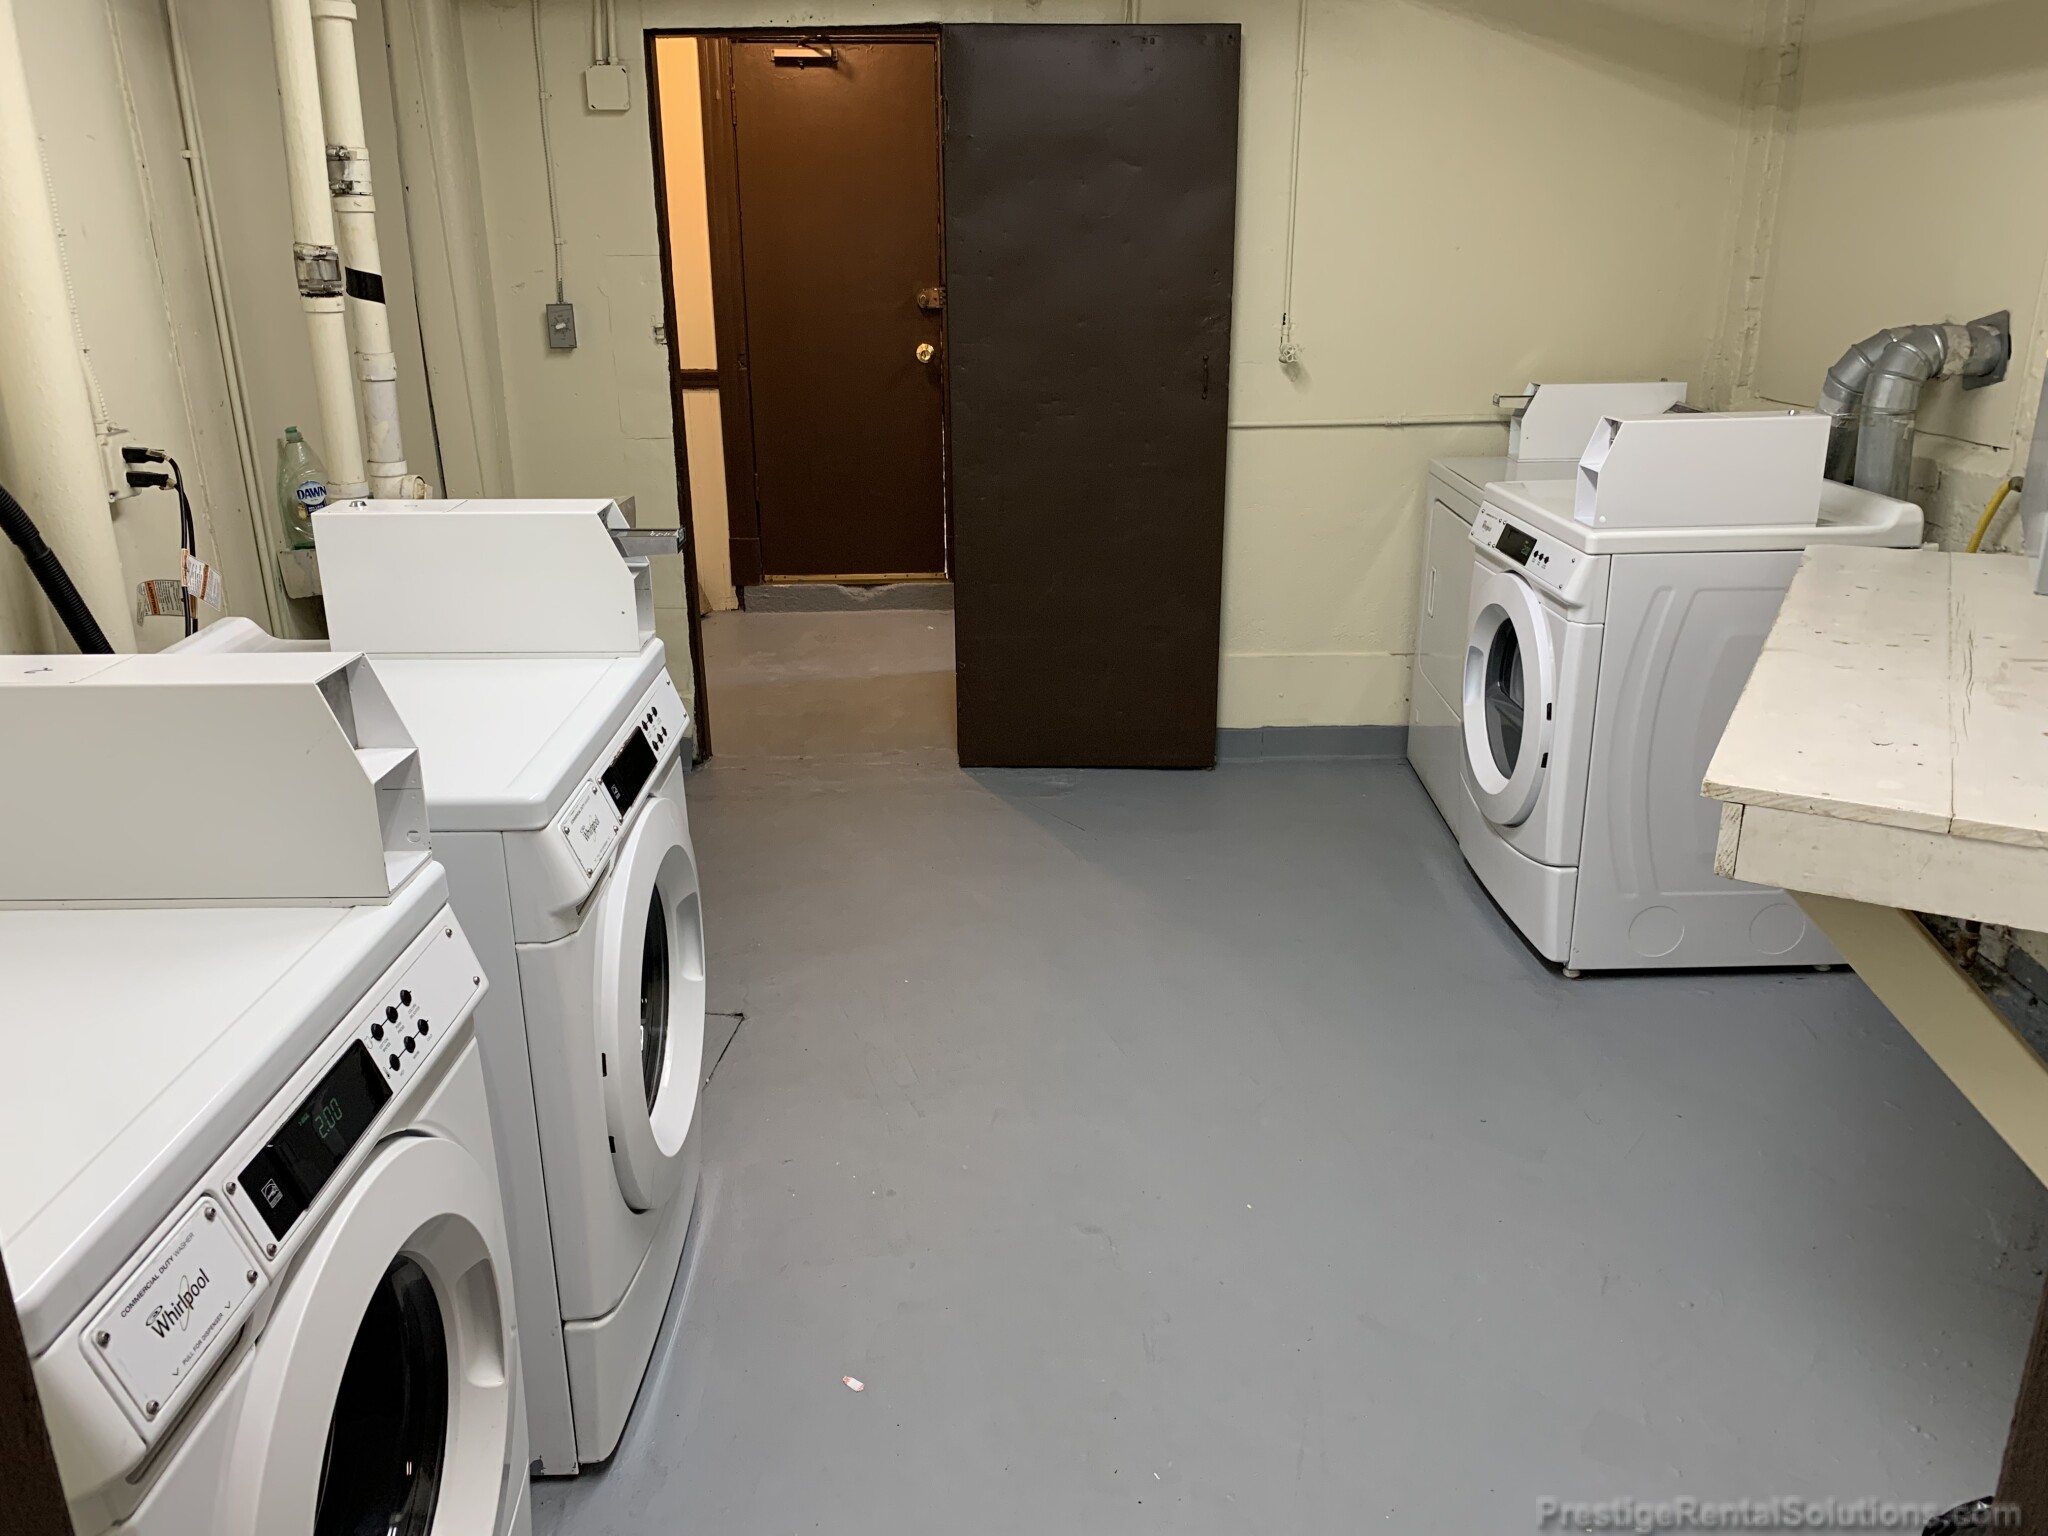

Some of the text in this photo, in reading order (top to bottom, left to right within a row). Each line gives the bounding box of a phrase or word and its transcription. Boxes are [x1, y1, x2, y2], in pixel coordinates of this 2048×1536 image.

[297, 486, 327, 500] DAWN
[120, 1232, 194, 1318] COMMERCIAL DUTY WASHER
[151, 1268, 210, 1338] Whirlpool
[182, 1312, 223, 1365] PULL FOR DISPENSER
